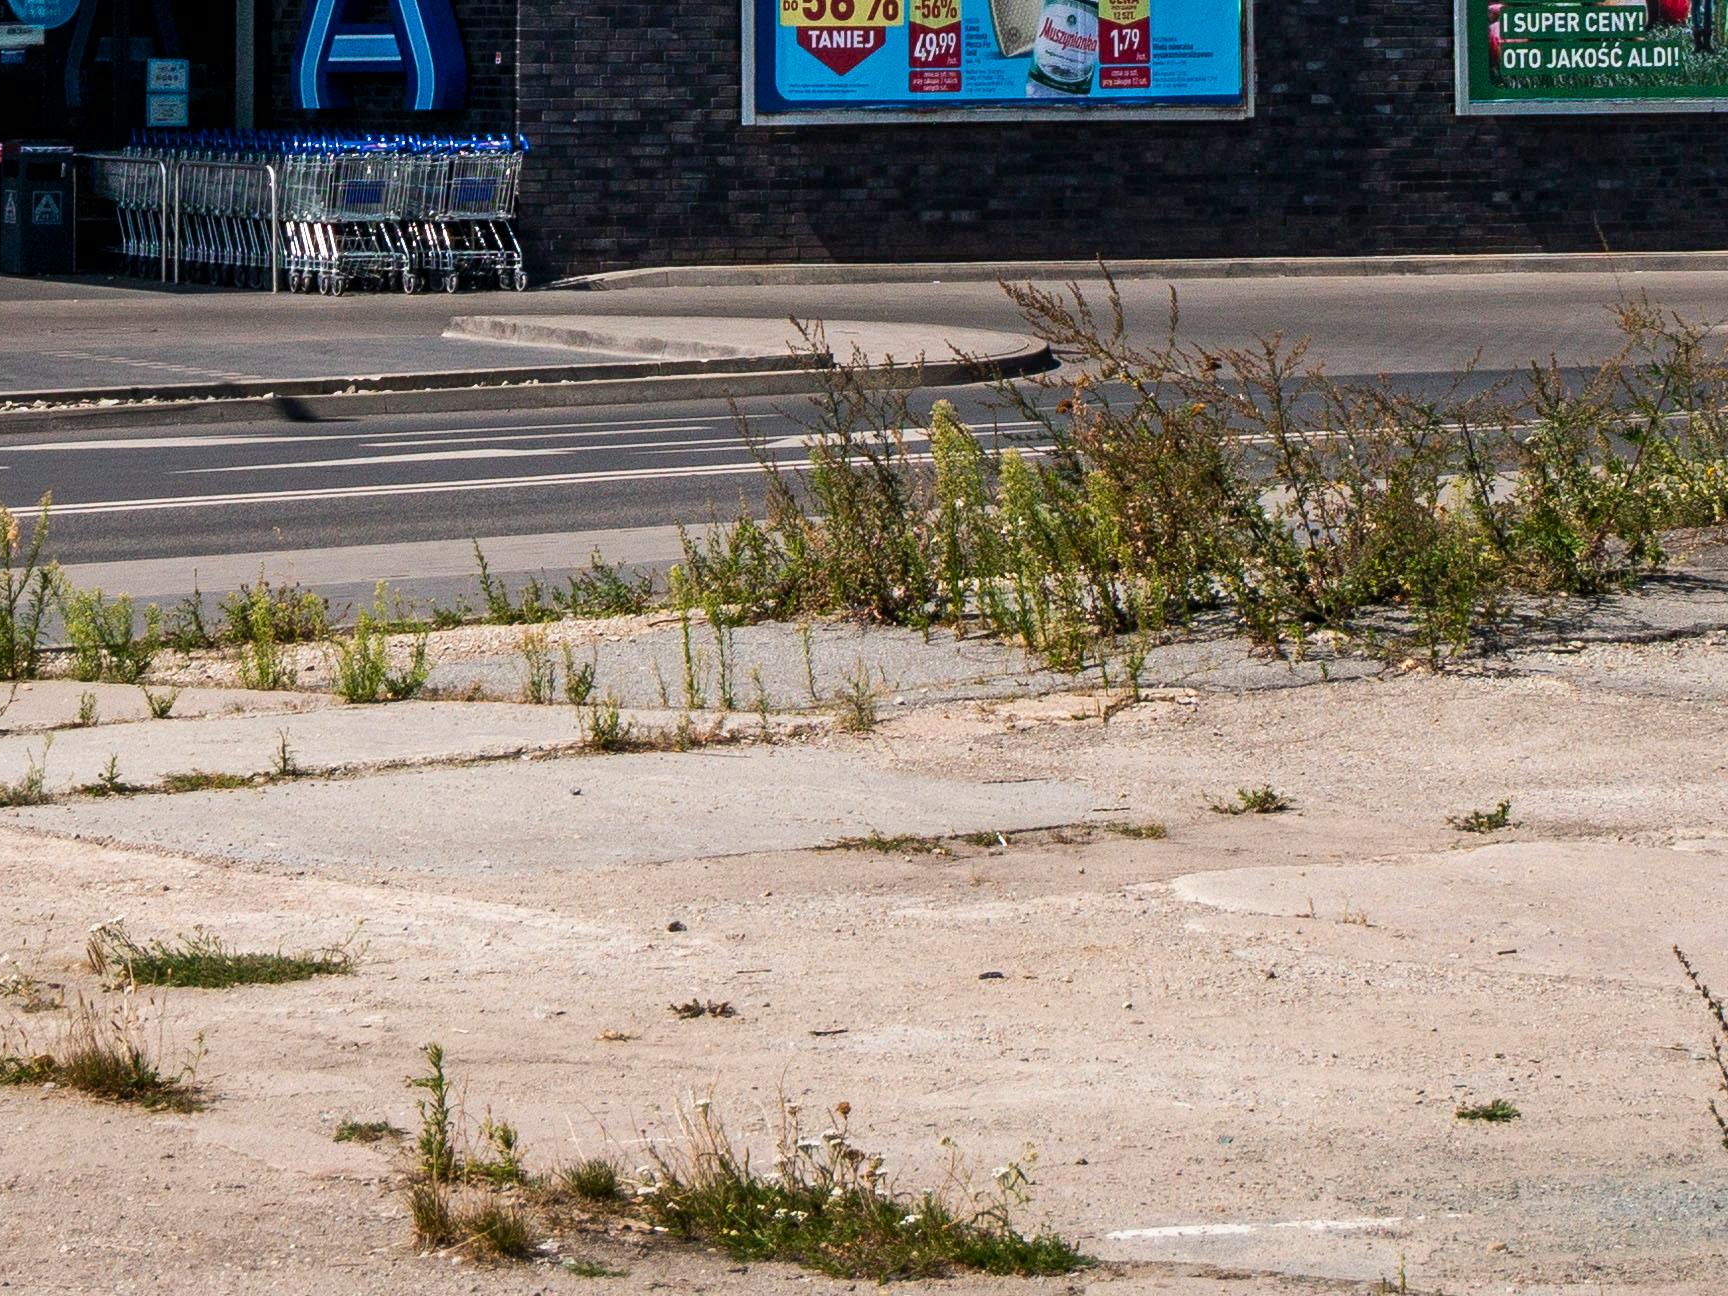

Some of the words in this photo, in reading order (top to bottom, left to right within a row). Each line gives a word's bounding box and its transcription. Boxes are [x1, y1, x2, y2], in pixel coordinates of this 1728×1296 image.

[783, 0, 799, 12] DO
[1113, 11, 1121, 19] 12
[1503, 13, 1508, 32] I
[1514, 13, 1579, 32] SUPER
[1585, 12, 1644, 32] CENY!
[808, 30, 875, 48] TANIEJ
[913, 32, 957, 62] 49,99
[1110, 29, 1141, 58] 1,79
[1503, 49, 1541, 68] OTO
[1546, 42, 1623, 68] JAKOŚĆ
[1627, 47, 1679, 67] ALDI!
